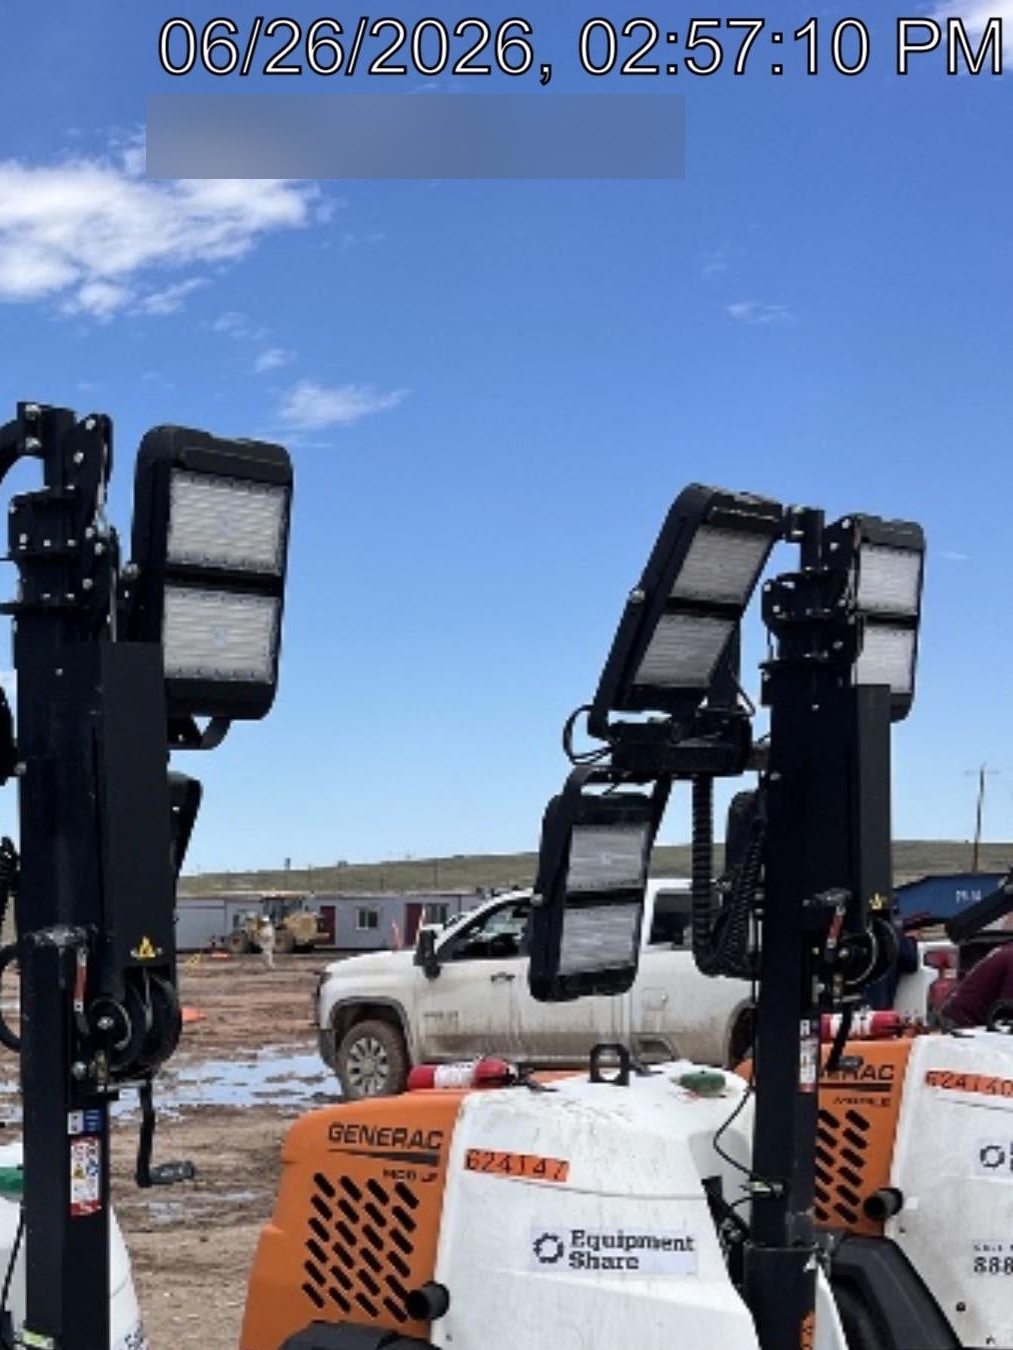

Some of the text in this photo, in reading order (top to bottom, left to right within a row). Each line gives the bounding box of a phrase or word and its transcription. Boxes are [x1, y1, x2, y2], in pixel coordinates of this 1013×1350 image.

[328, 1122, 443, 1151] GENERAC
[467, 1149, 567, 1181] 624147
[570, 1229, 694, 1252] Equipment
[569, 1250, 639, 1270] Share
